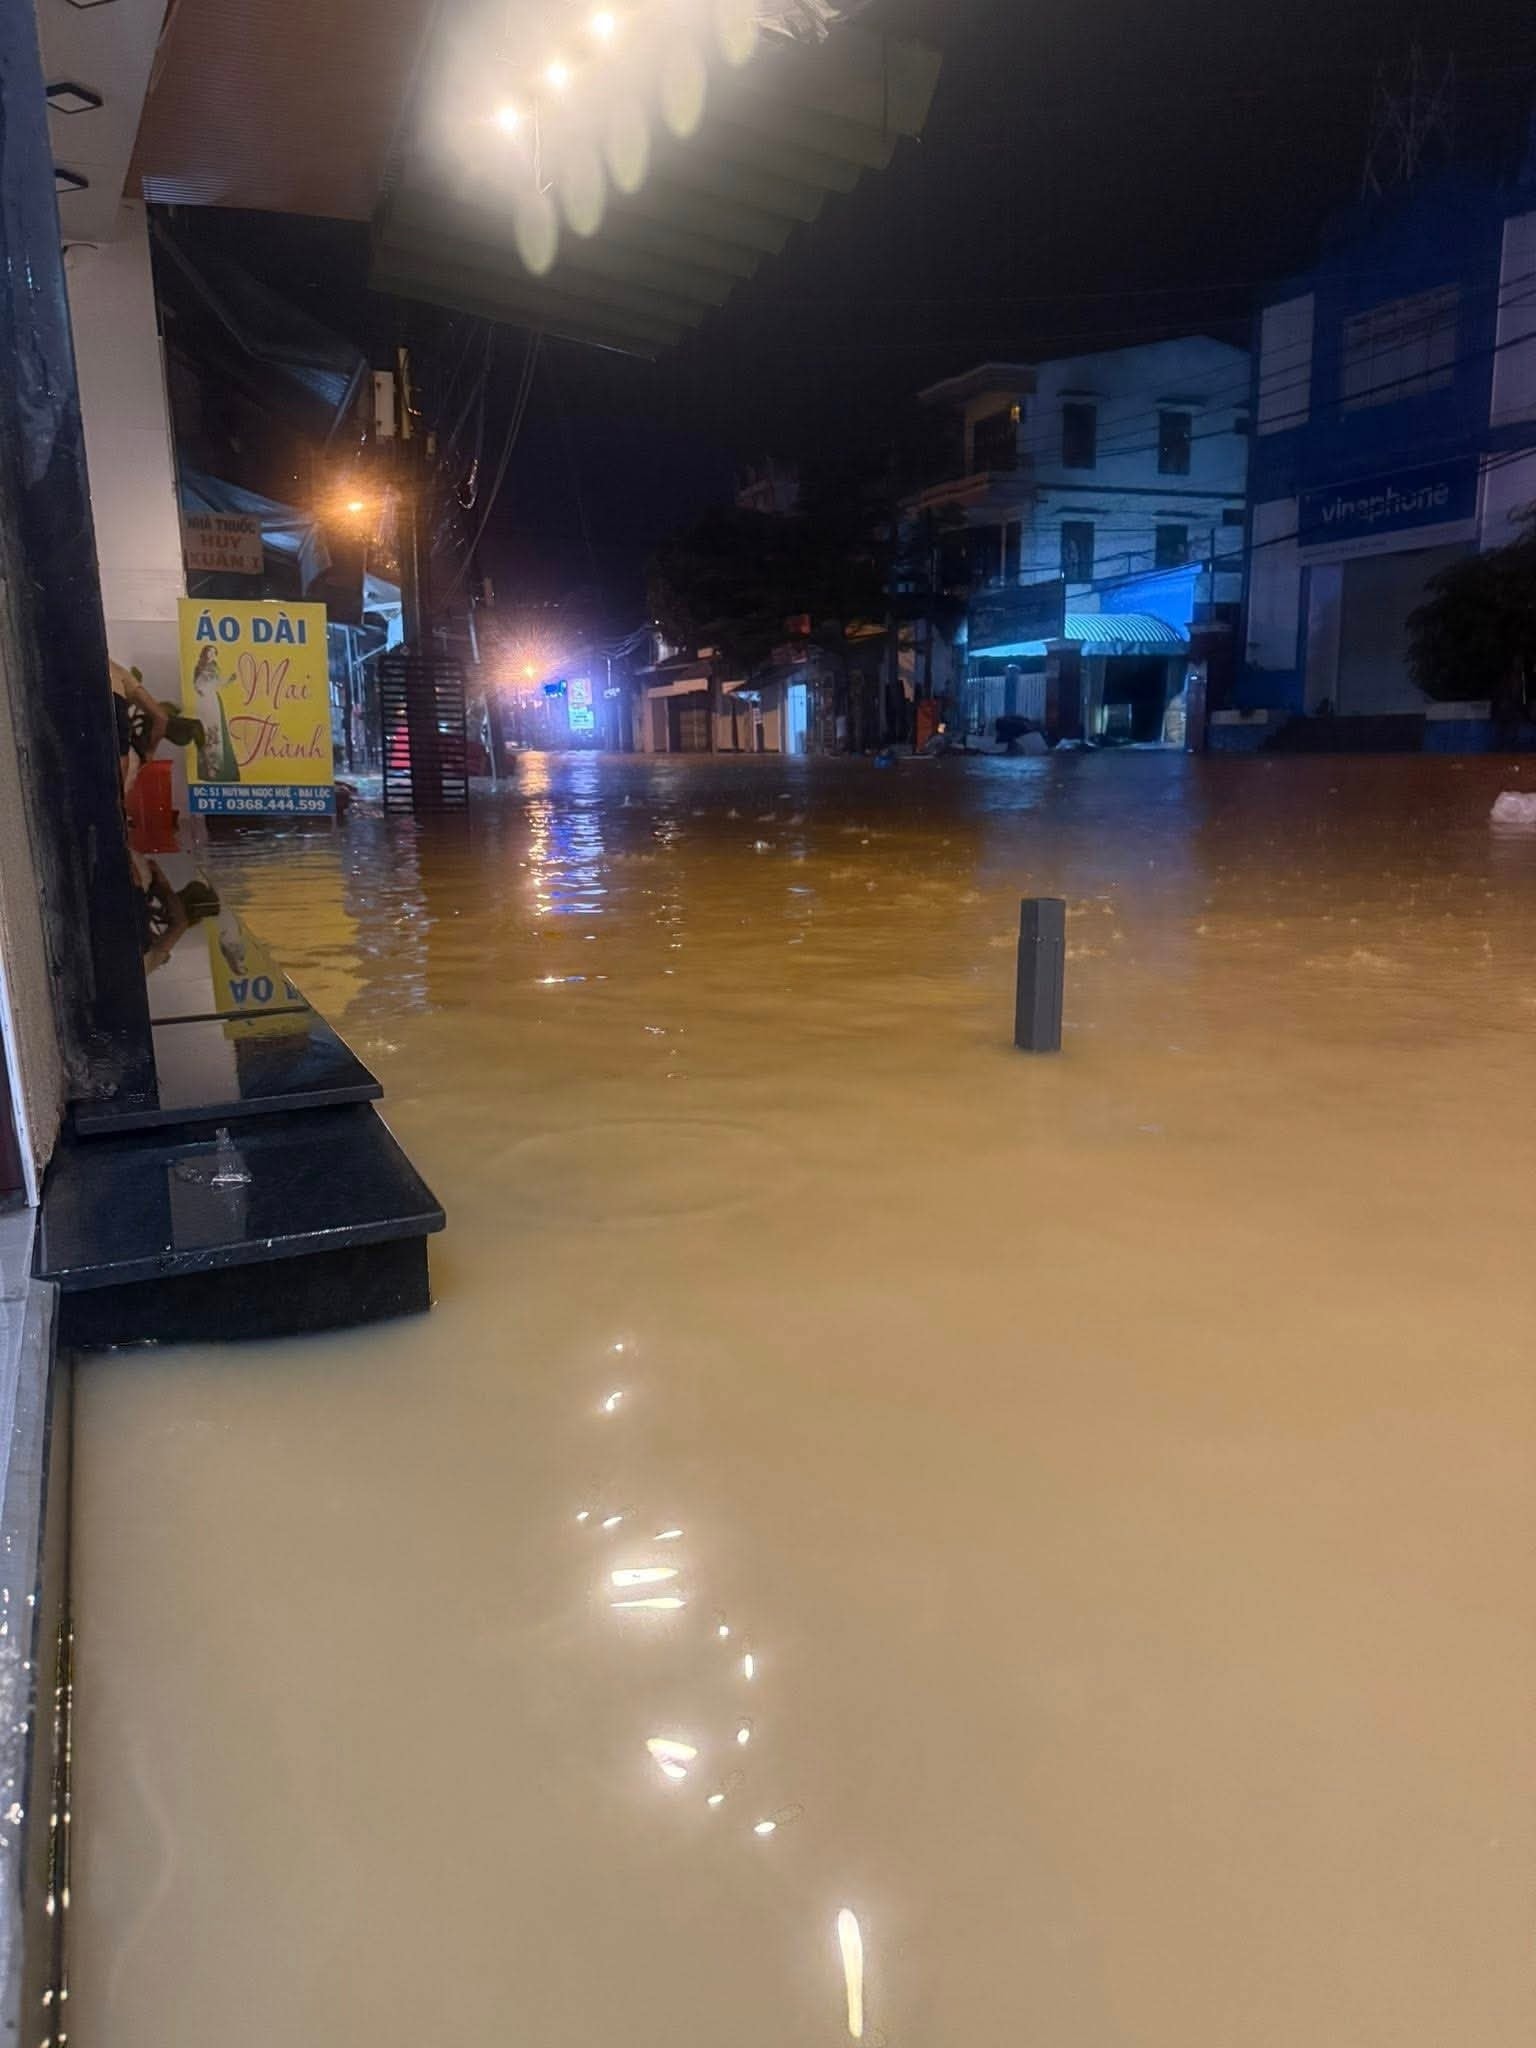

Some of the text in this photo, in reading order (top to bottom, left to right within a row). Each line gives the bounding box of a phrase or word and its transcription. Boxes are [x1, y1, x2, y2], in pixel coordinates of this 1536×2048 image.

[196, 609, 307, 645] ÁO DÀI
[237, 651, 311, 710] Mai
[229, 715, 325, 767] Thành
[226, 799, 326, 811] 0368.444.599
